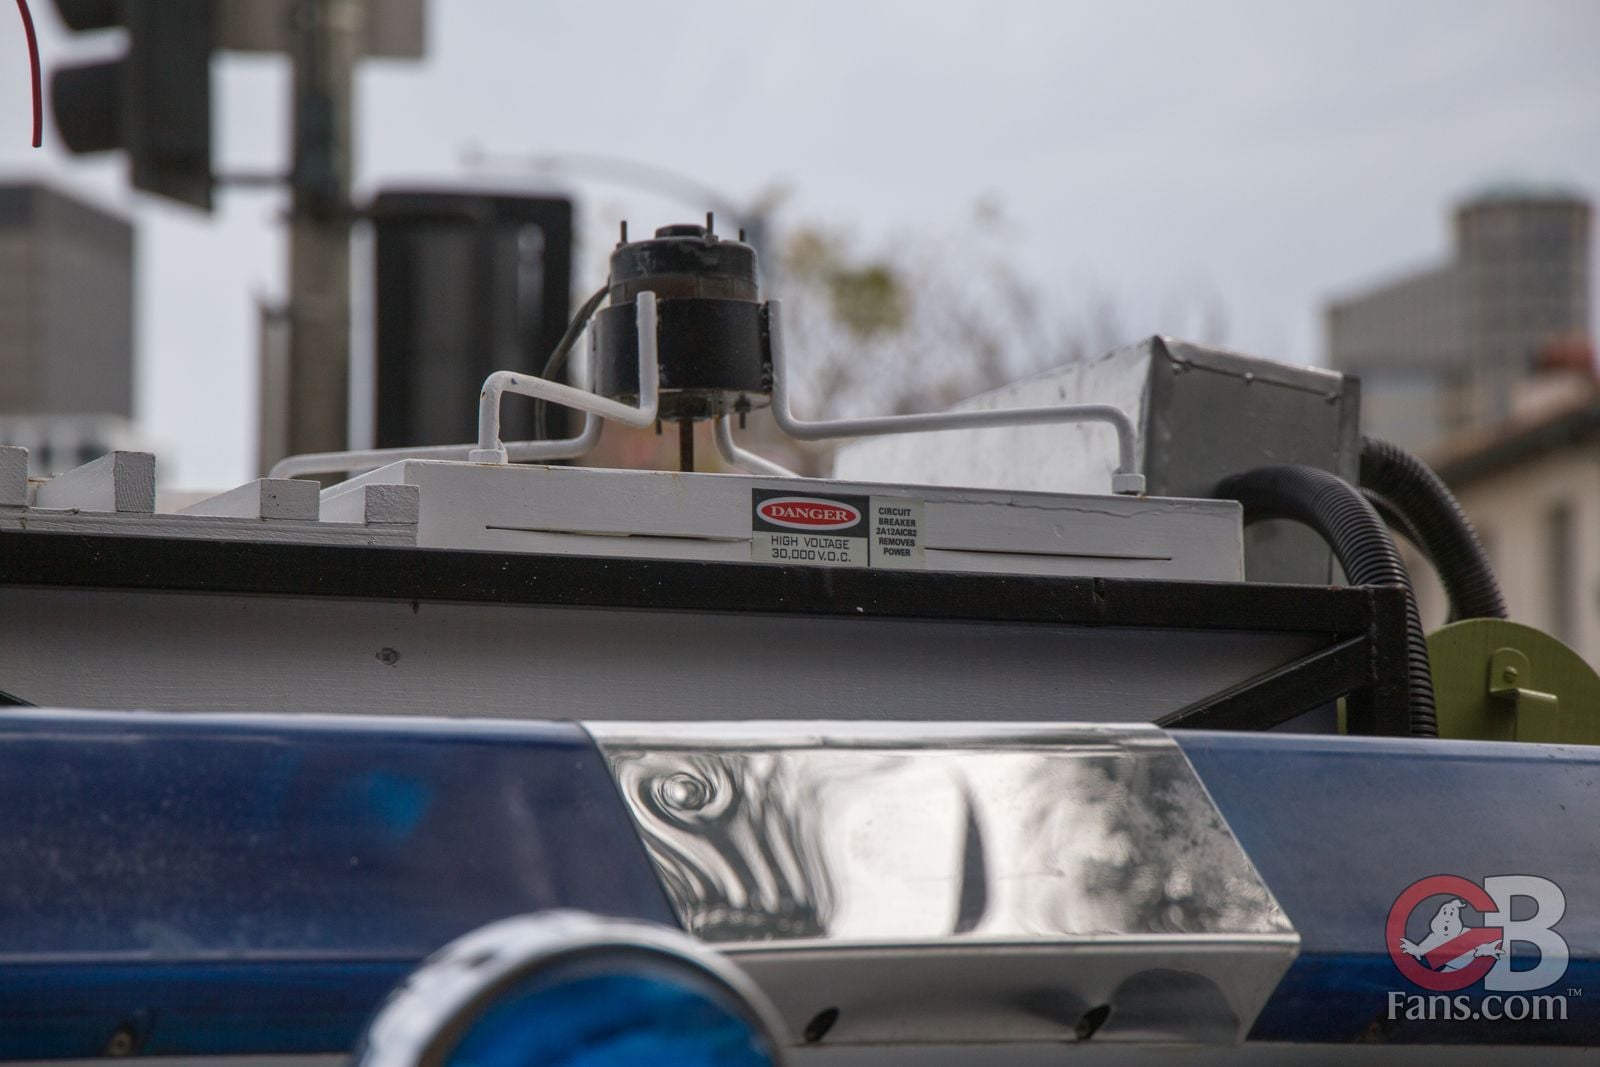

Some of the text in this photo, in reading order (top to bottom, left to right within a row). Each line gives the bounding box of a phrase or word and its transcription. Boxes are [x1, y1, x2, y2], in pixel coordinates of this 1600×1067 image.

[771, 506, 848, 521] DANGER
[878, 507, 911, 517] CIRCUIT
[878, 518, 916, 527] BREAKER
[771, 535, 849, 550] HIGH VOLTAGE
[878, 537, 915, 547] REMOVES
[772, 548, 816, 561] 30,000
[883, 548, 911, 557] POWER
